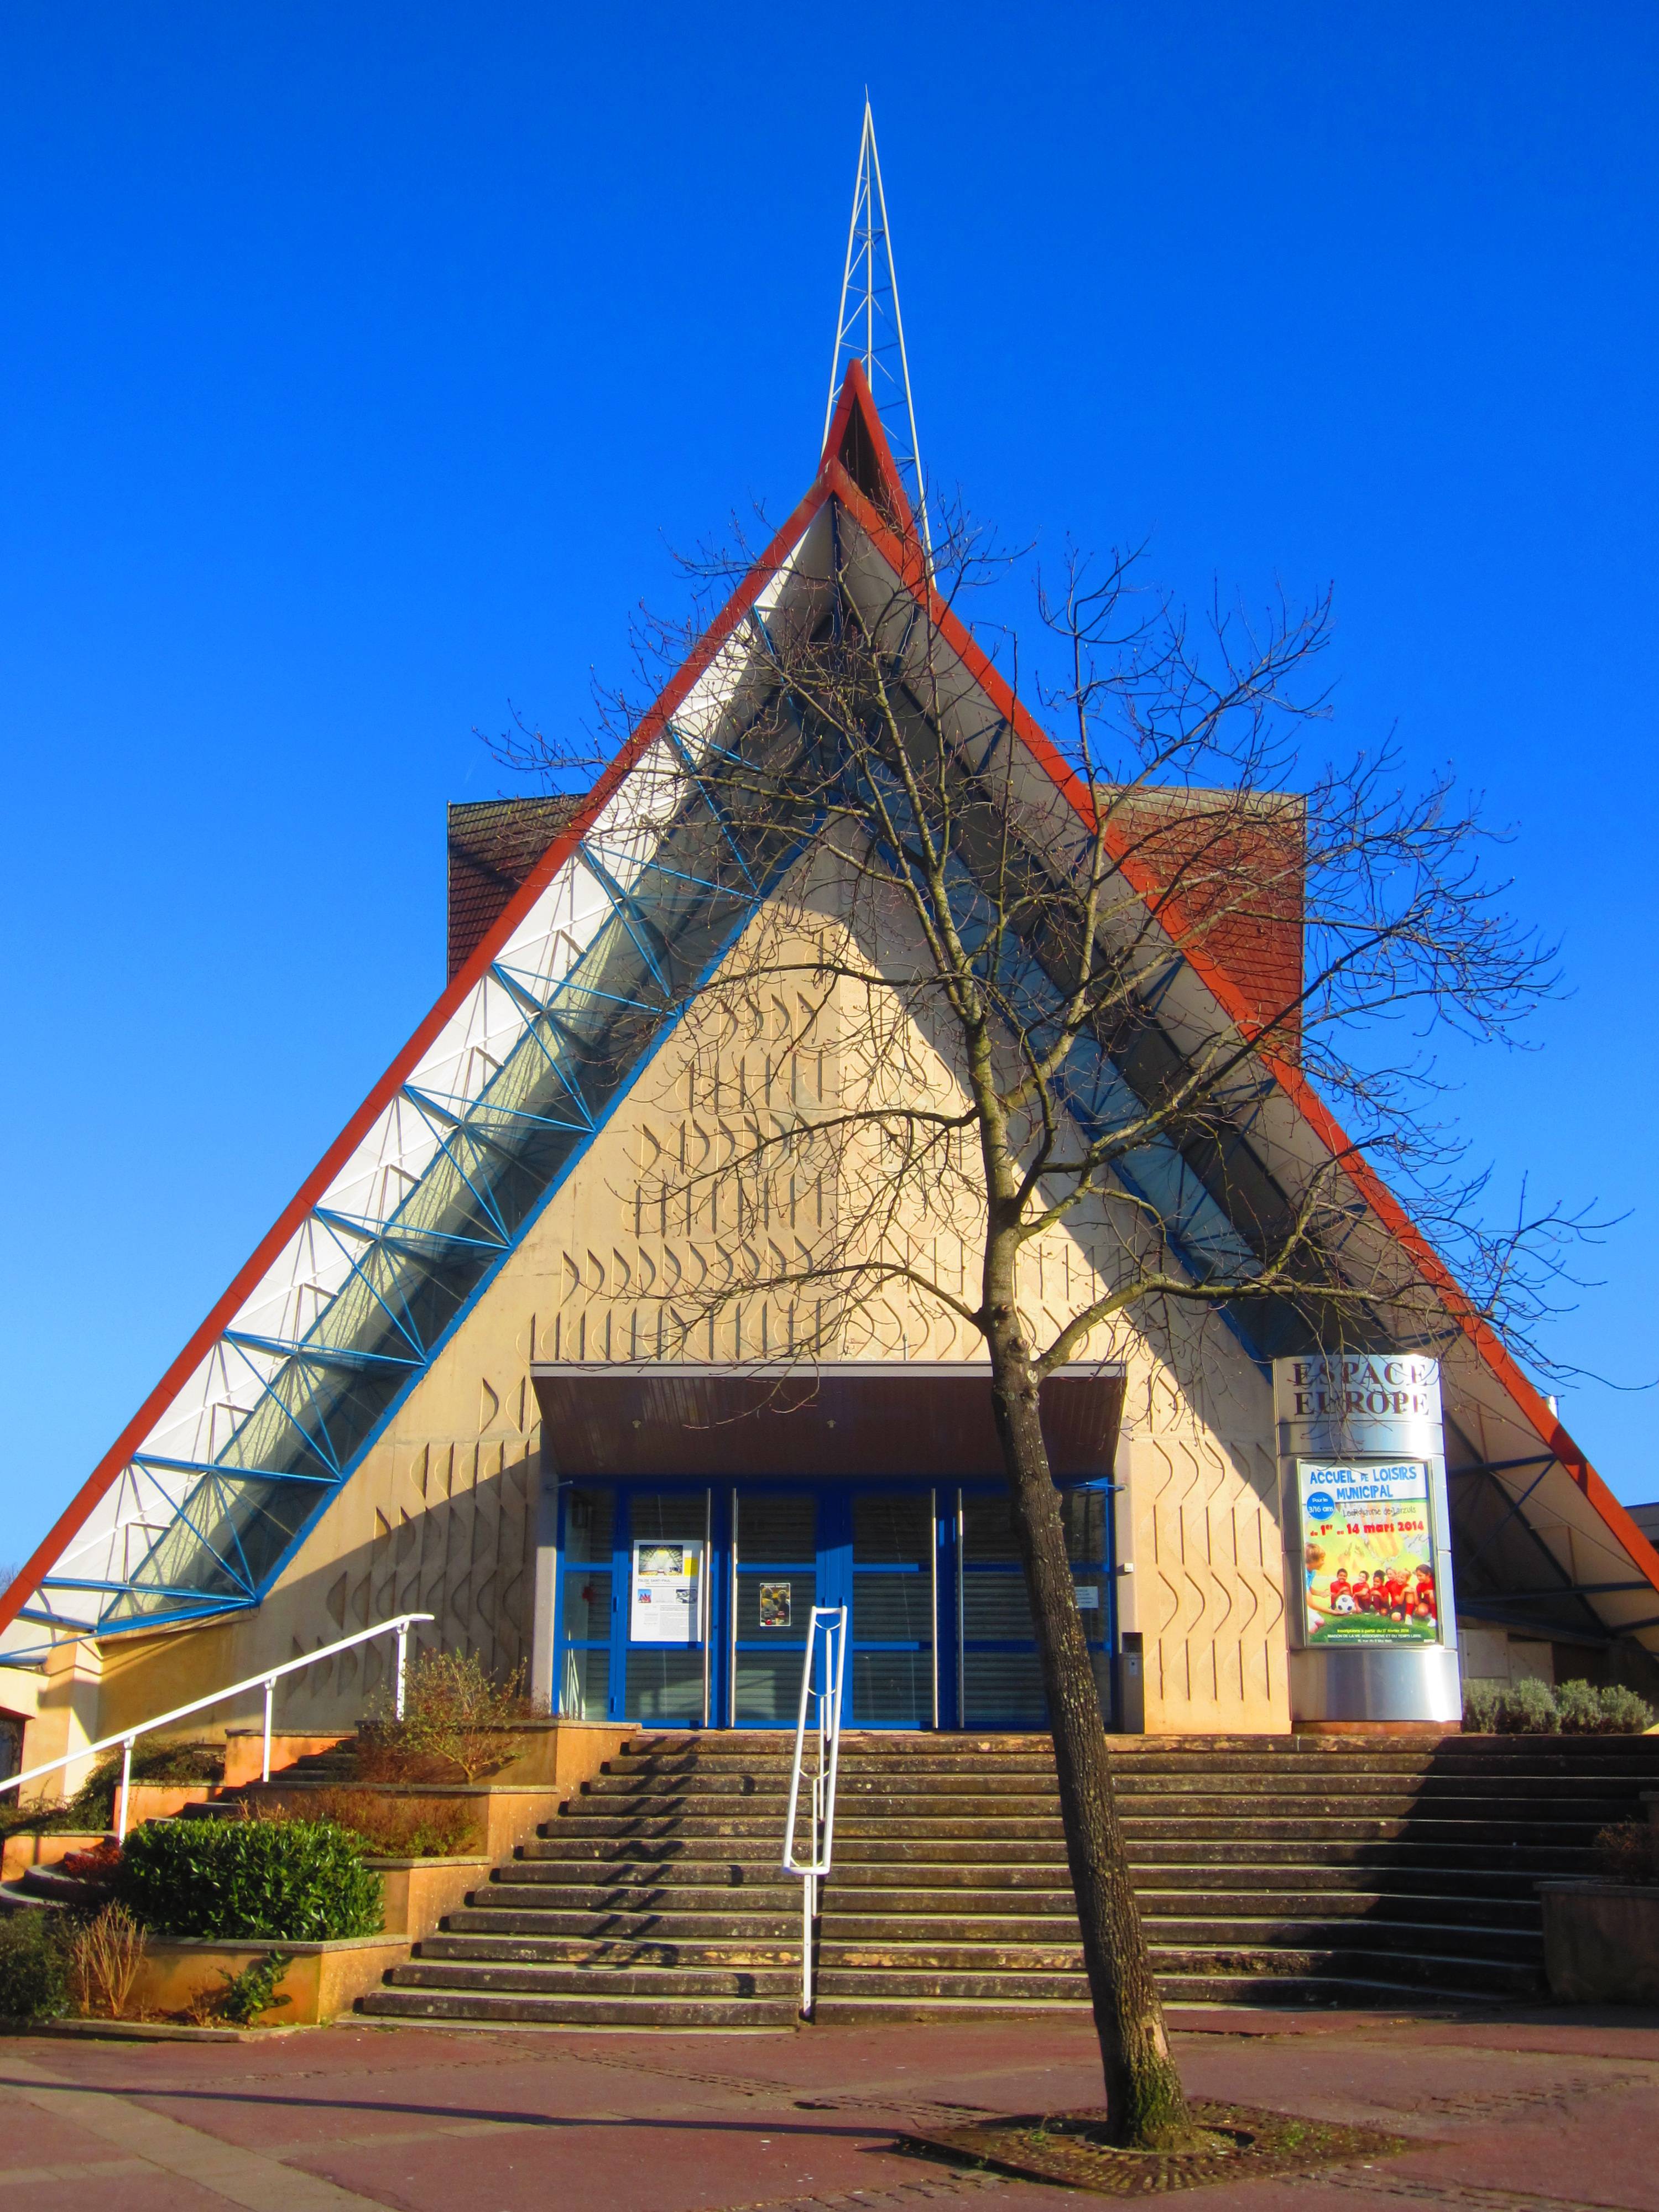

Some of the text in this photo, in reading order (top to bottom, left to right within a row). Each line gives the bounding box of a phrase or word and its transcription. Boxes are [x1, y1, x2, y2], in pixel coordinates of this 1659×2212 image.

[1292, 1361, 1428, 1387] ESPACE
[1294, 1390, 1429, 1416] EUROPE
[1310, 1470, 1356, 1484] ACCUEIL
[1373, 1467, 1417, 1482] LOISIRS
[1337, 1485, 1393, 1500] MUNICIPAL
[1321, 1524, 1333, 1536] 1er
[1346, 1523, 1360, 1535] 14
[1364, 1522, 1394, 1533] mars
[1398, 1521, 1424, 1531] 2014
